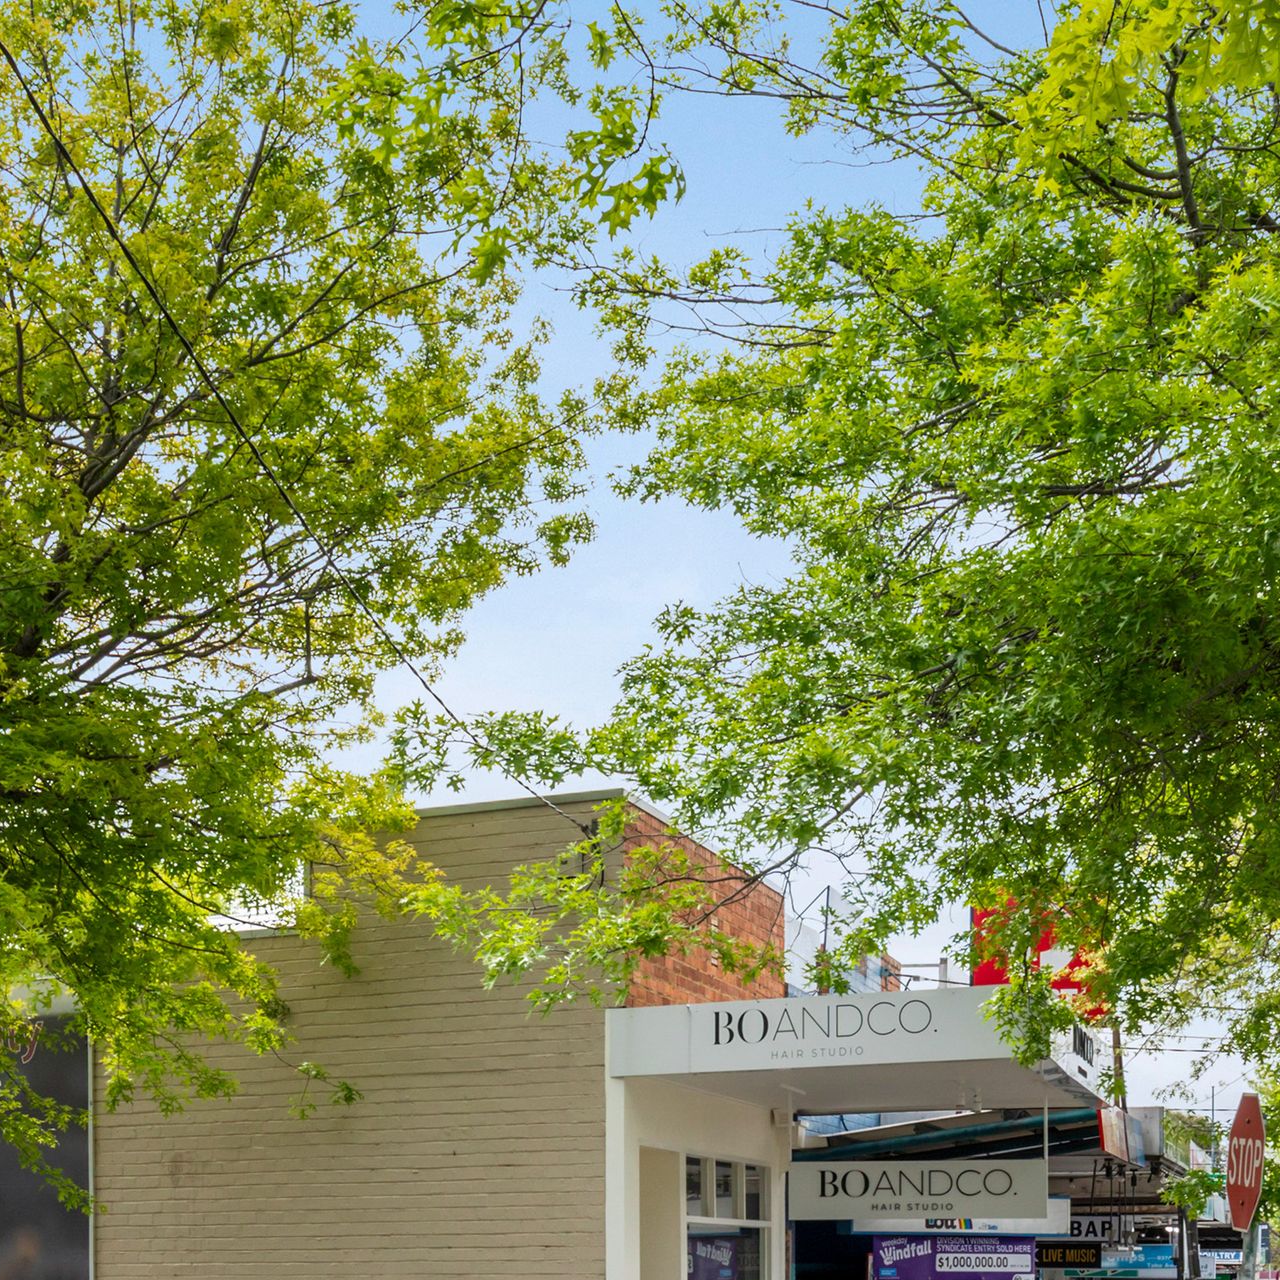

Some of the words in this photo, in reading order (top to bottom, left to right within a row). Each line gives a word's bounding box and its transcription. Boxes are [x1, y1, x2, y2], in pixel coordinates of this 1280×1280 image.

[713, 999, 937, 1045] BOANDCO.
[771, 1049, 804, 1060] HAIR
[811, 1046, 864, 1058] STUDIO
[1229, 1136, 1262, 1188] STOP
[819, 1168, 1018, 1198] BOANDCO.
[871, 1203, 901, 1211] HAIR
[907, 1203, 954, 1211] STUDIO
[936, 1236, 965, 1245] DIVISION
[879, 1239, 932, 1266] Windfall
[936, 1245, 972, 1253] SYNDICATE
[974, 1245, 996, 1253] ENTRY
[996, 1245, 1014, 1253] SOLD
[1042, 1248, 1064, 1263] LIVE
[1065, 1248, 1097, 1263] MUSIC
[938, 1256, 1009, 1269] $1,000,000.00
